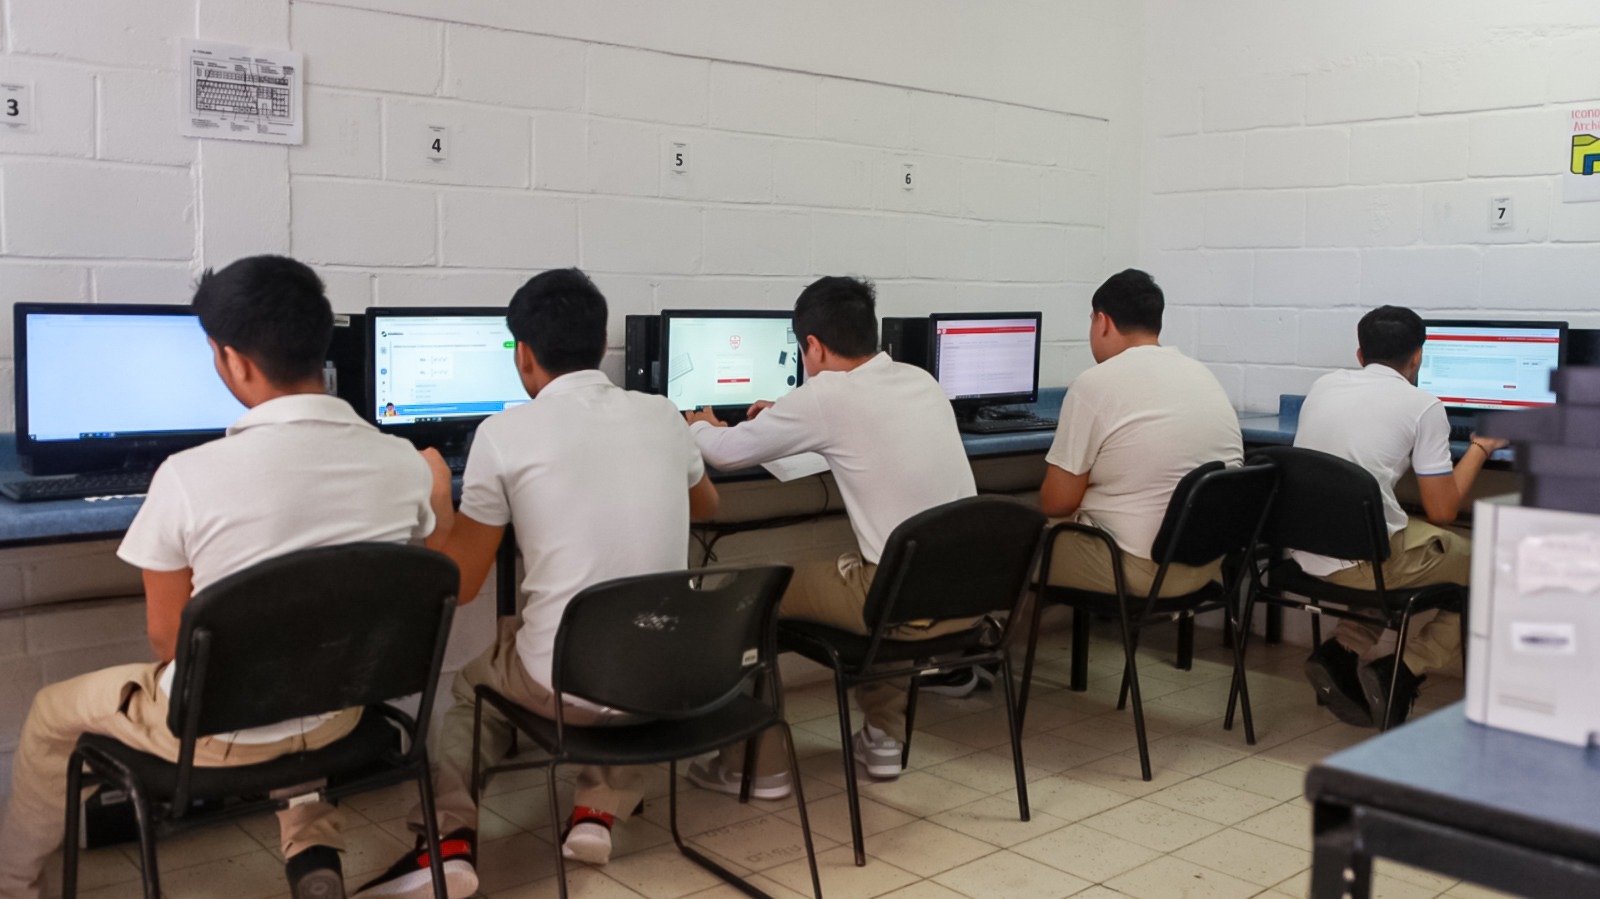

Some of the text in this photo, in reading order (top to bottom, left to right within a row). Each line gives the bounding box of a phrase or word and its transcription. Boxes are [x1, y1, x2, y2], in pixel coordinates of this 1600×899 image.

[6, 98, 19, 116] 3
[431, 138, 442, 153] 4
[675, 153, 683, 166] 5
[905, 173, 911, 184] 6
[1497, 207, 1506, 219] 7
